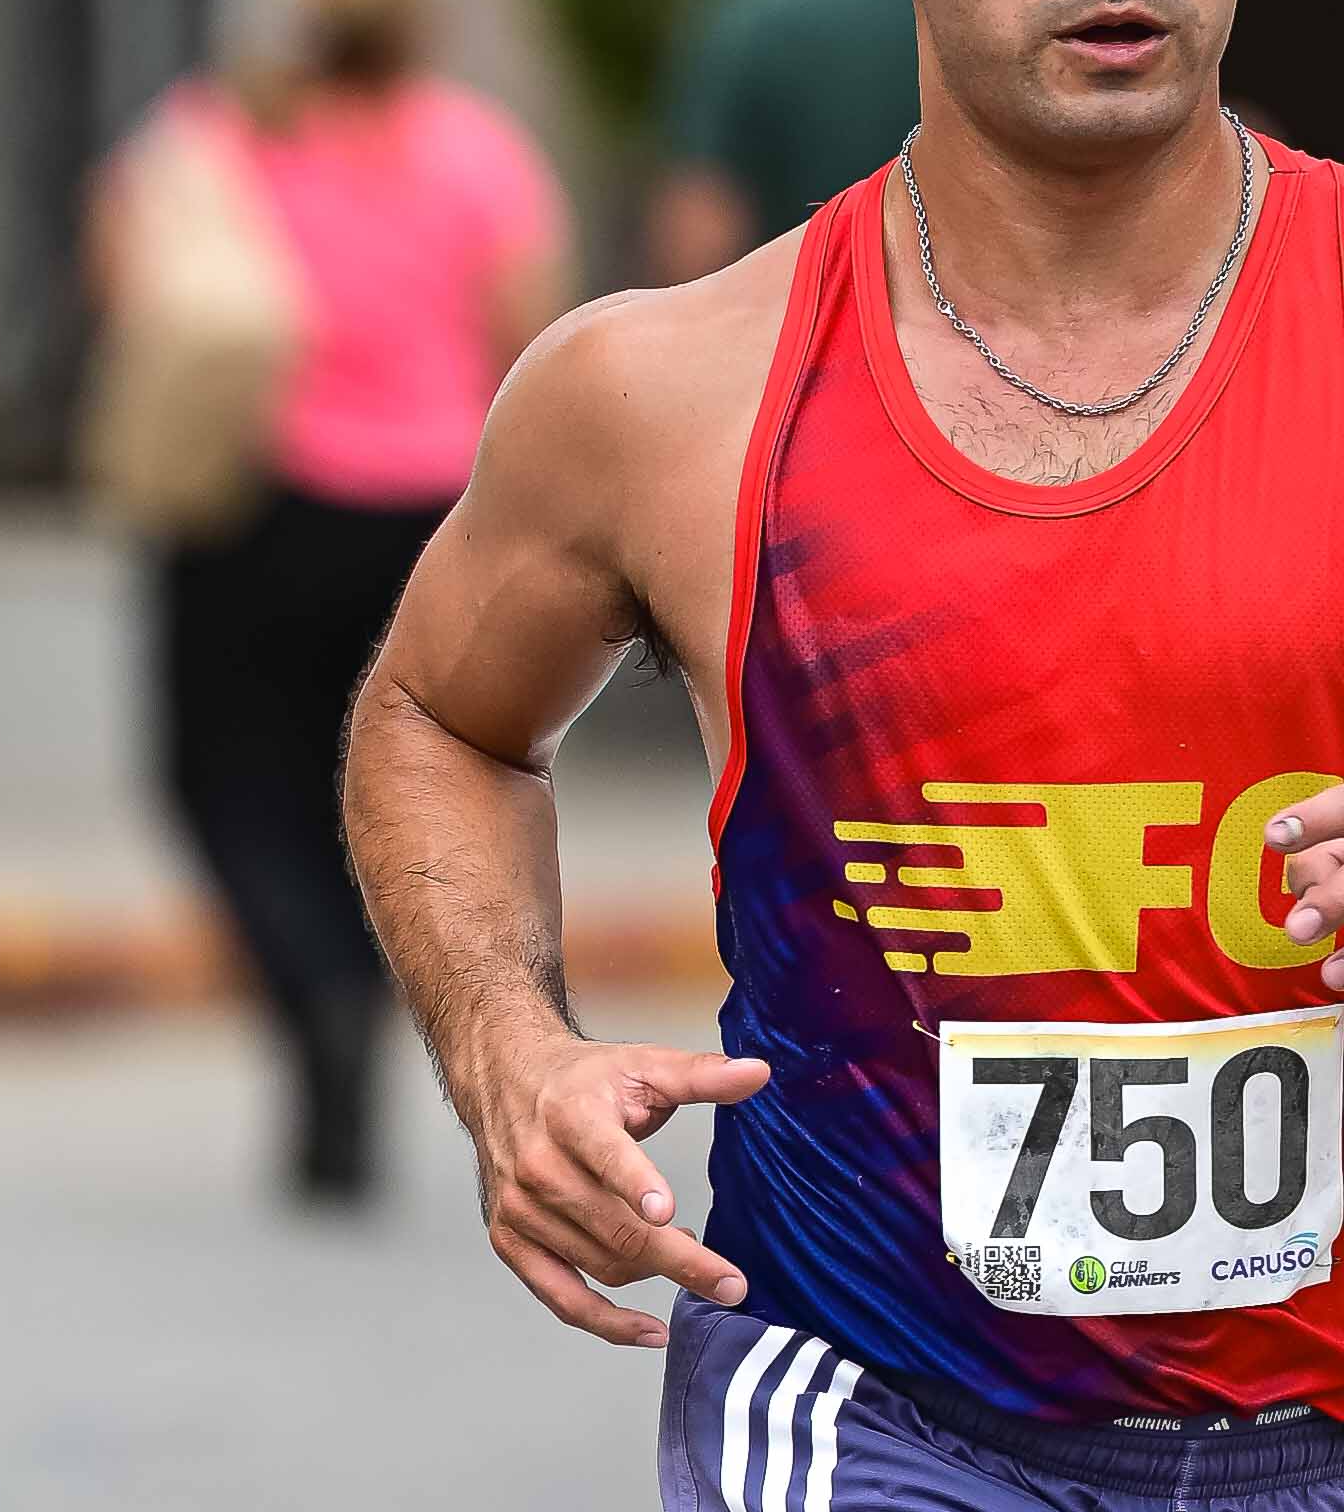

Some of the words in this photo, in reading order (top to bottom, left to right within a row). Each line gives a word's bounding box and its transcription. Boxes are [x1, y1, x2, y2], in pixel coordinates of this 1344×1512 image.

[972, 1045, 1311, 1241] 750
[1110, 1260, 1149, 1275] CLUB
[1211, 1247, 1316, 1281] CARUSO
[1107, 1271, 1182, 1289] RUNNER'S
[1255, 1405, 1311, 1426] RUNNING
